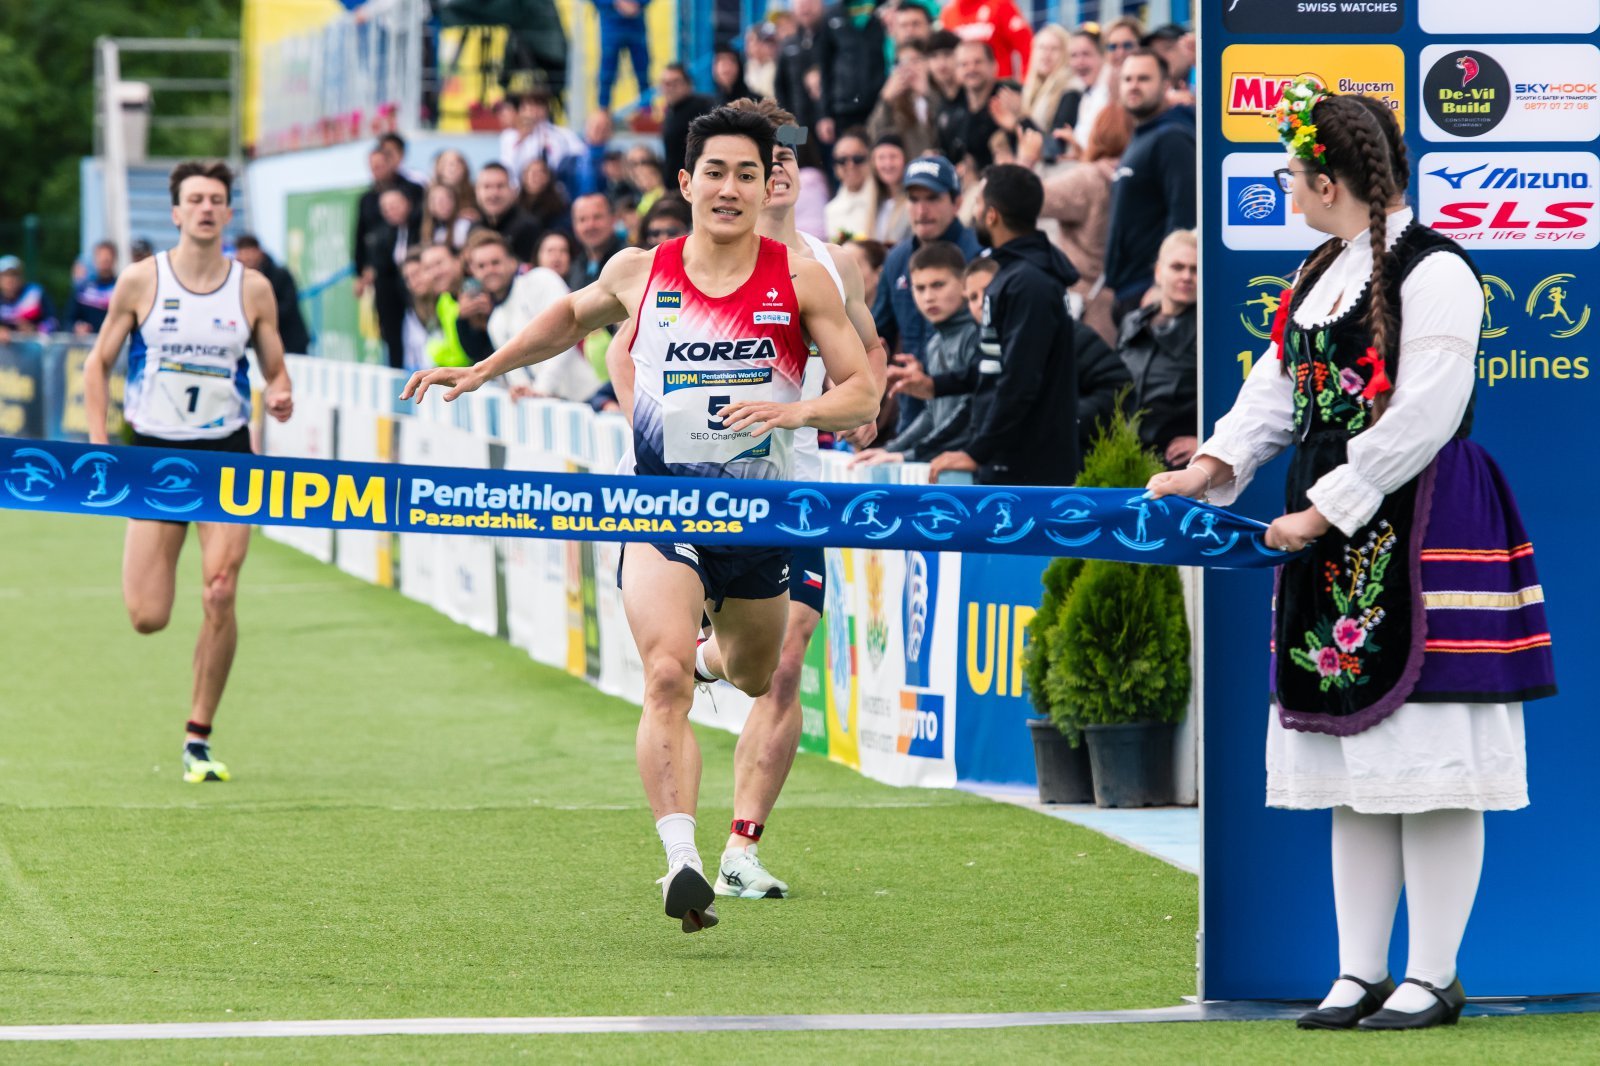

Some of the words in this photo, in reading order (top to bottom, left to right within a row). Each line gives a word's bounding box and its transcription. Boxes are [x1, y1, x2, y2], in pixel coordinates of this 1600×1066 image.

[1297, 3, 1337, 13] SWISS
[1340, 3, 1398, 13] WATCHES
[1339, 79, 1394, 96] вкусът
[1439, 88, 1495, 100] De-Vil
[1515, 84, 1597, 93] SKYHOOK
[1442, 102, 1491, 114] Build
[1524, 102, 1547, 110] 0877
[1550, 102, 1561, 110] 07
[1564, 102, 1574, 110] 27
[1431, 202, 1595, 229] SLS
[1442, 232, 1484, 240] port
[1492, 231, 1526, 240] life
[1534, 231, 1585, 241] style
[161, 344, 228, 358] FRANCE
[665, 339, 776, 362] KOREA
[1237, 350, 1252, 380] 1
[1478, 350, 1590, 387] iplines
[667, 373, 698, 385] UIPM
[185, 386, 200, 412] 1
[707, 396, 731, 430] 5
[690, 432, 709, 440] SEO
[711, 431, 752, 440] Changwan
[219, 466, 387, 524] UIPM
[410, 478, 592, 512] Pentathlon
[601, 487, 700, 517] World
[706, 491, 770, 523] Cup
[410, 508, 545, 531] Pazardzhik,
[552, 515, 676, 533] BULGARIA
[681, 520, 743, 533] 2026
[966, 602, 1037, 698] UIP
